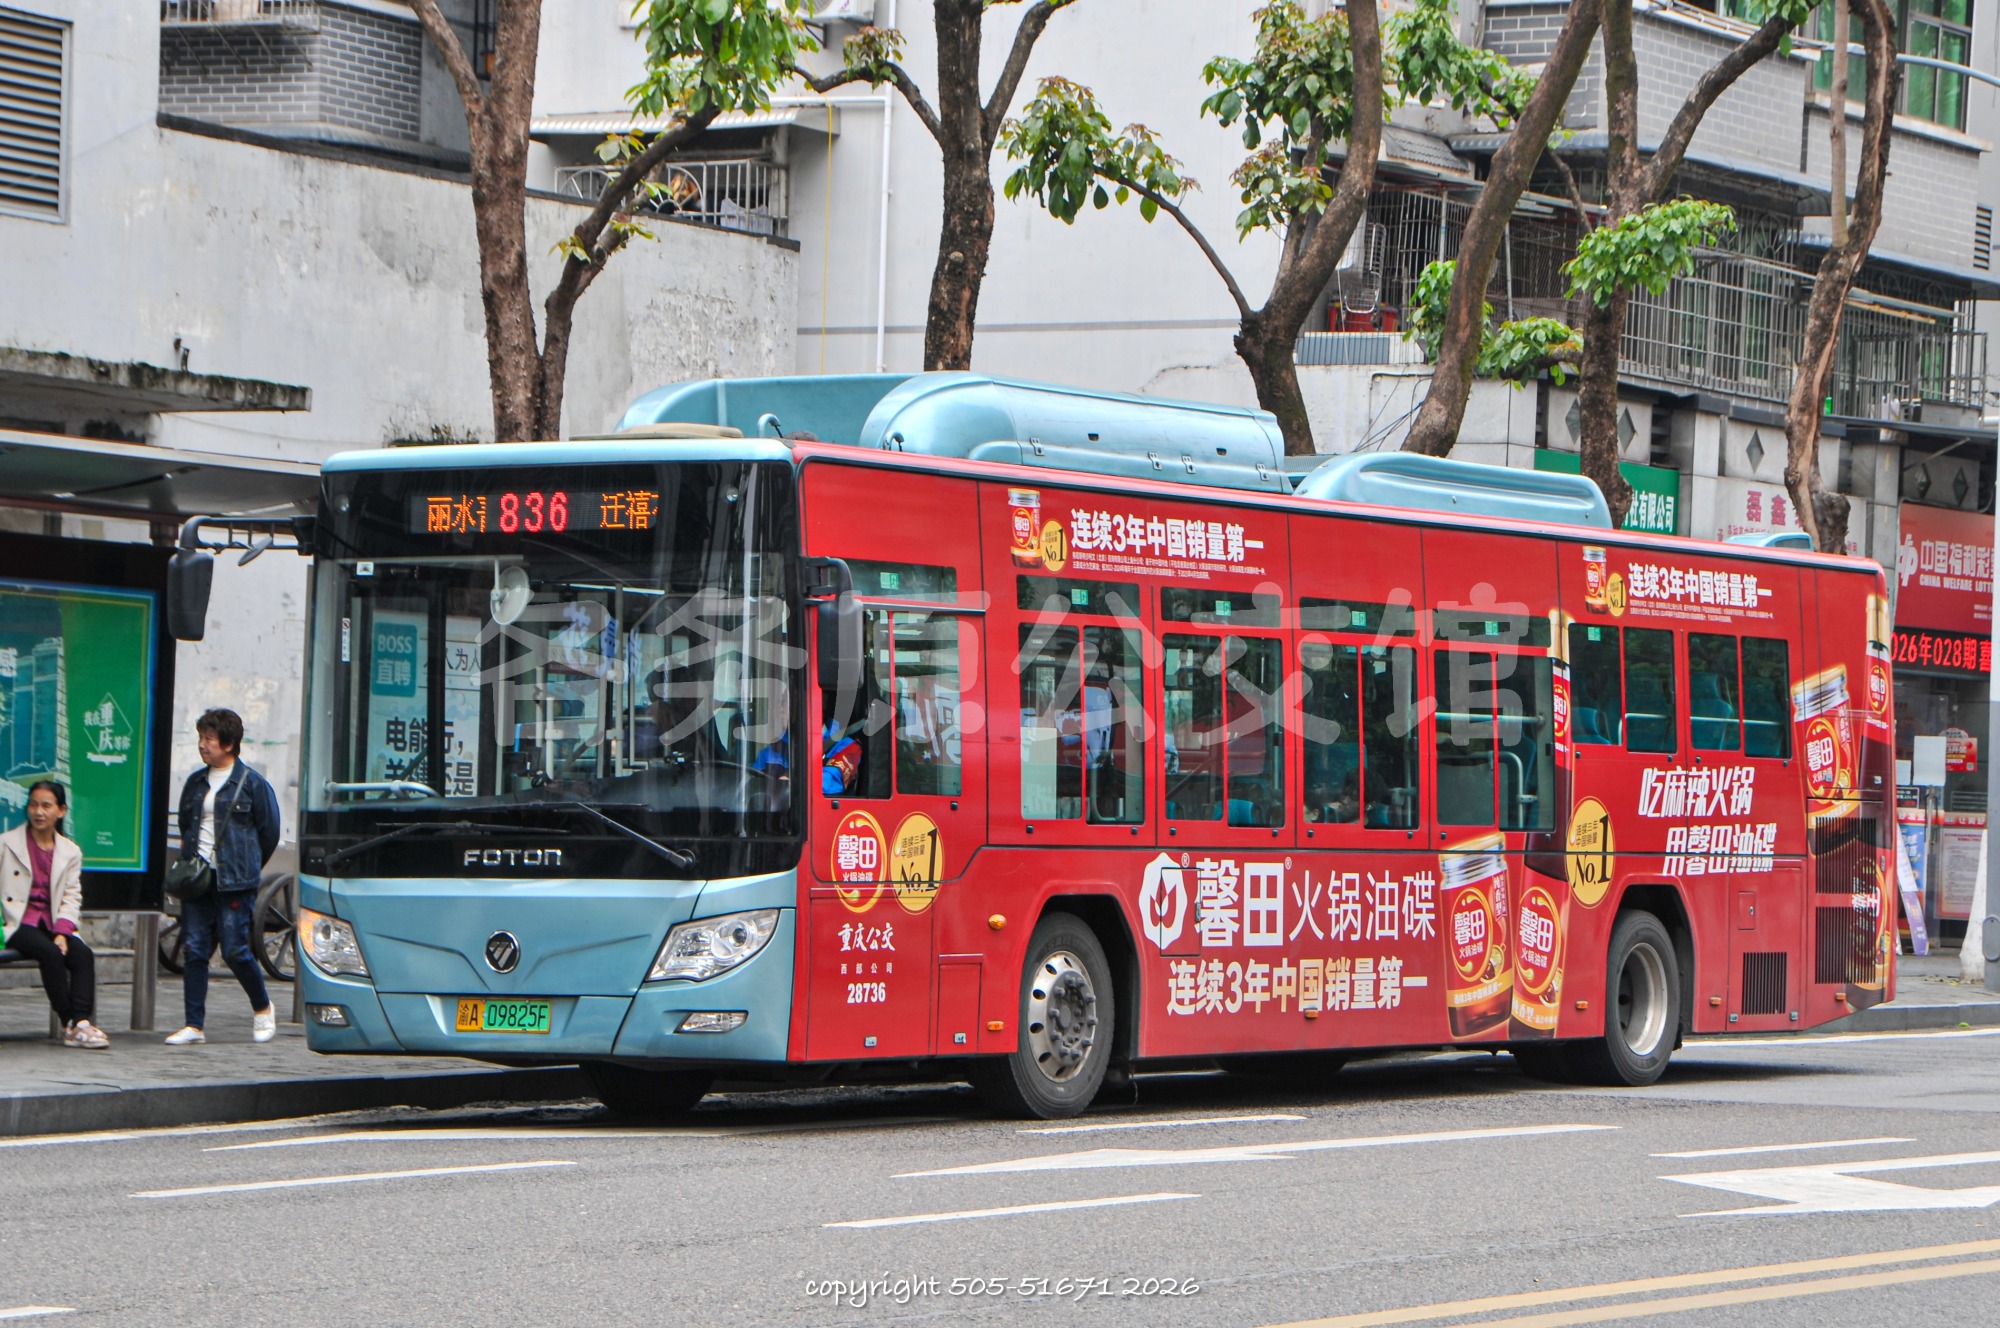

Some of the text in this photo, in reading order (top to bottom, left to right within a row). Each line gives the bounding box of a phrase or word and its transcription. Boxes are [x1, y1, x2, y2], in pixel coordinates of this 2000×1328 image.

[499, 491, 569, 534] 836
[1625, 490, 1675, 533] 社有限公司
[1746, 490, 1802, 529] 磊鑫
[1070, 508, 1265, 563] 连续3年中国销量第一
[1920, 540, 1995, 579] 中国福利彩
[1628, 562, 1773, 609] 连续3年中国销量第一
[1919, 573, 1941, 588] CHINA
[1943, 577, 1973, 592] WELFARE
[377, 634, 412, 654] BOSS
[376, 658, 412, 686] 直聘
[1806, 737, 1834, 772] 馨田
[1638, 766, 1755, 818] 吃麻辣火锅
[464, 849, 561, 867] FOTON
[838, 834, 877, 870] 馨田
[1194, 857, 1284, 947] 馨田
[1289, 869, 1436, 942] 火锅油碟
[838, 922, 896, 952] 重庆公交
[1454, 908, 1486, 945] 馨田
[1519, 906, 1555, 953] 馨田
[847, 981, 886, 1004] 28736
[1167, 955, 1428, 1016] 连续3年中国销量第一
